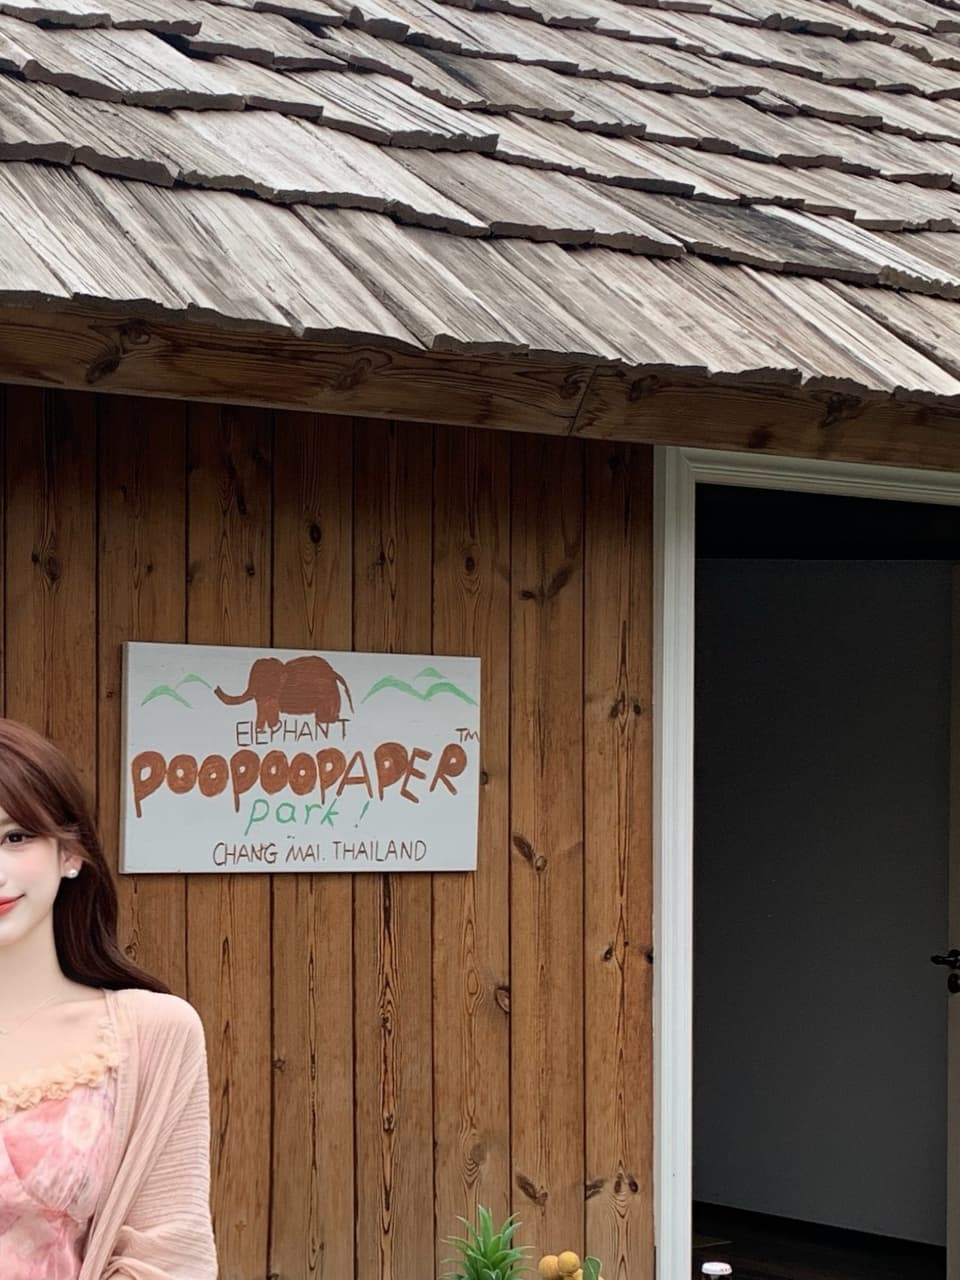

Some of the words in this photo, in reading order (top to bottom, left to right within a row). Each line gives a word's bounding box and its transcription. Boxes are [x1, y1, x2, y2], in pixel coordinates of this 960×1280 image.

[131, 742, 468, 818] POOPOOPAPER
[212, 842, 279, 867] CHANG
[332, 839, 428, 863] THAILAND
